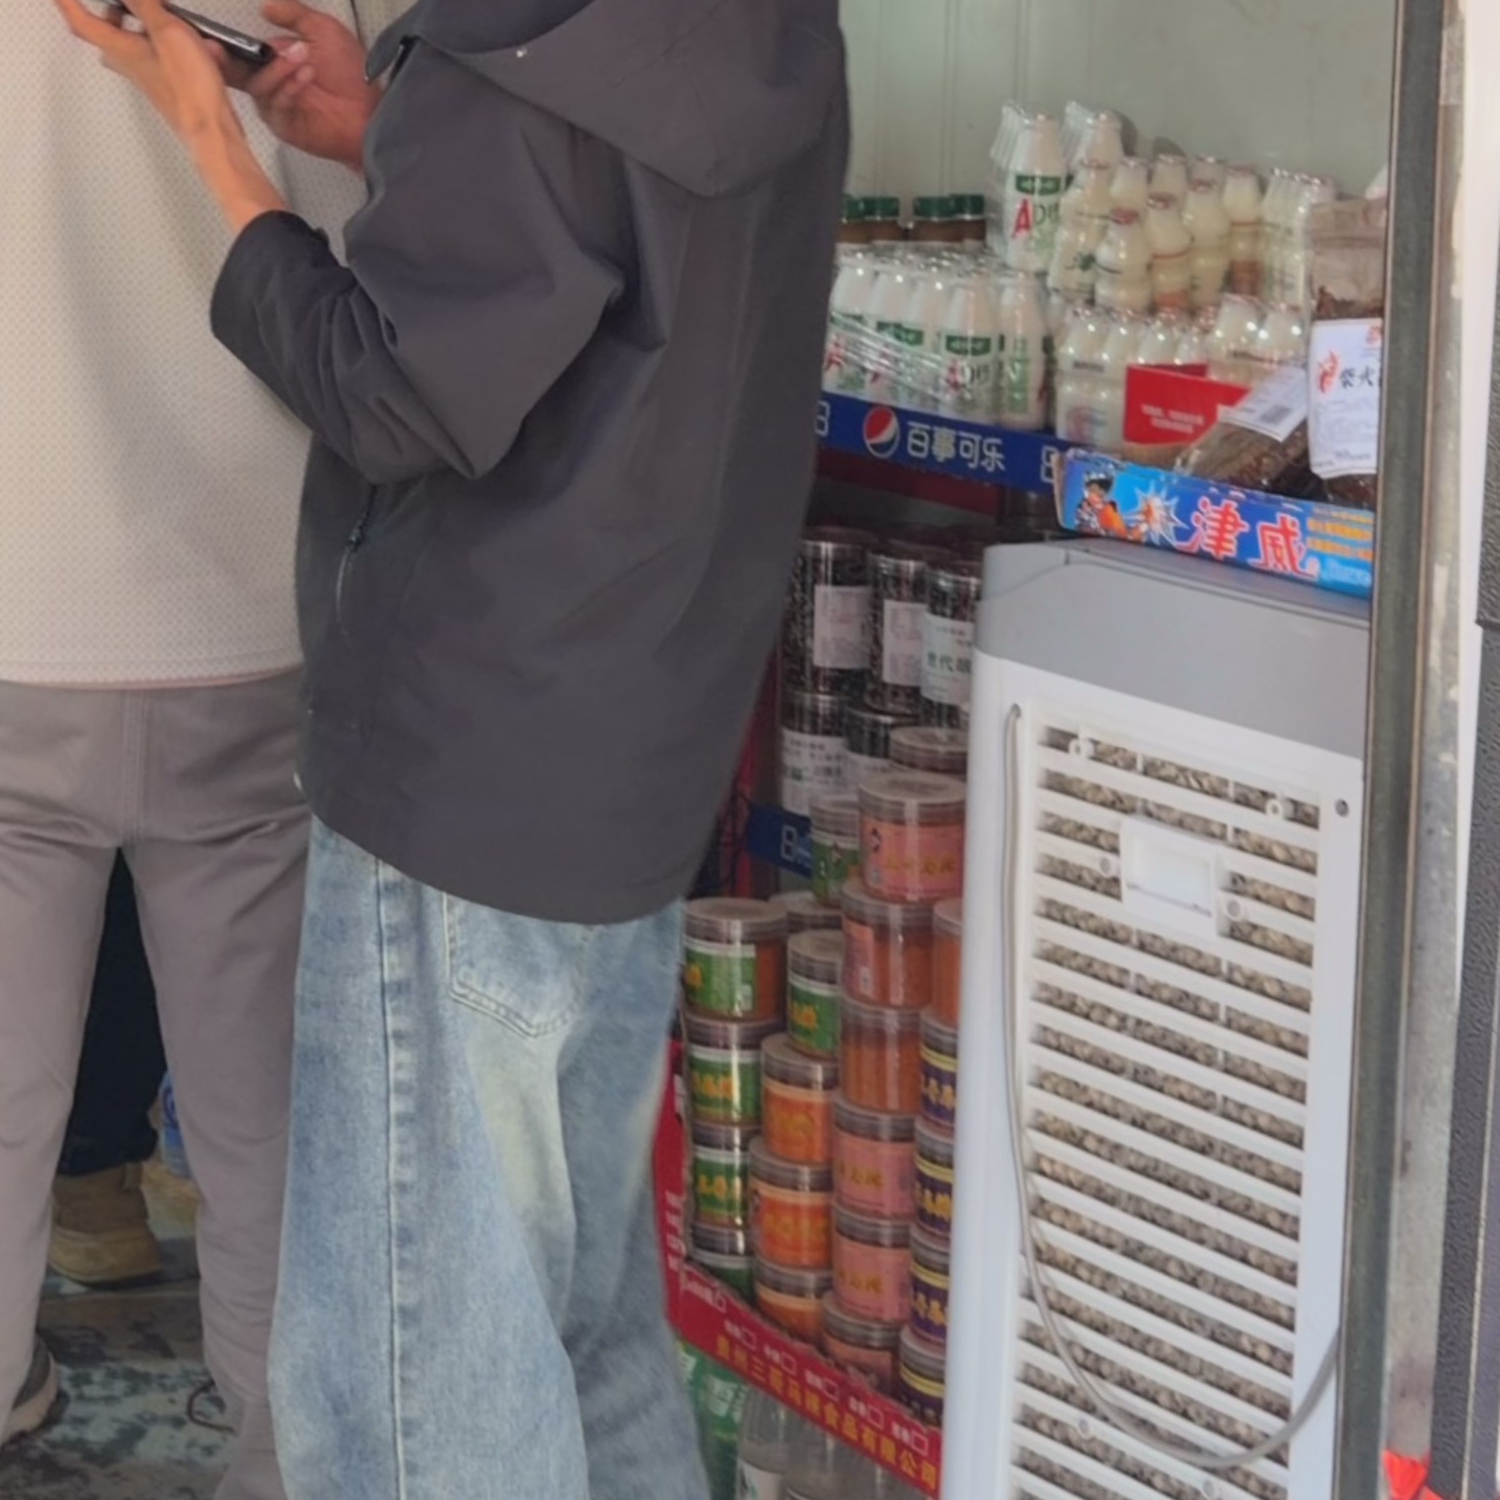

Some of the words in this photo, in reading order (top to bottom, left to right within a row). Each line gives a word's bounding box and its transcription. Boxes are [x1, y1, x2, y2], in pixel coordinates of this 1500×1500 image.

[906, 420, 1005, 472] 百事可乐
[1175, 496, 1321, 580] 津威
